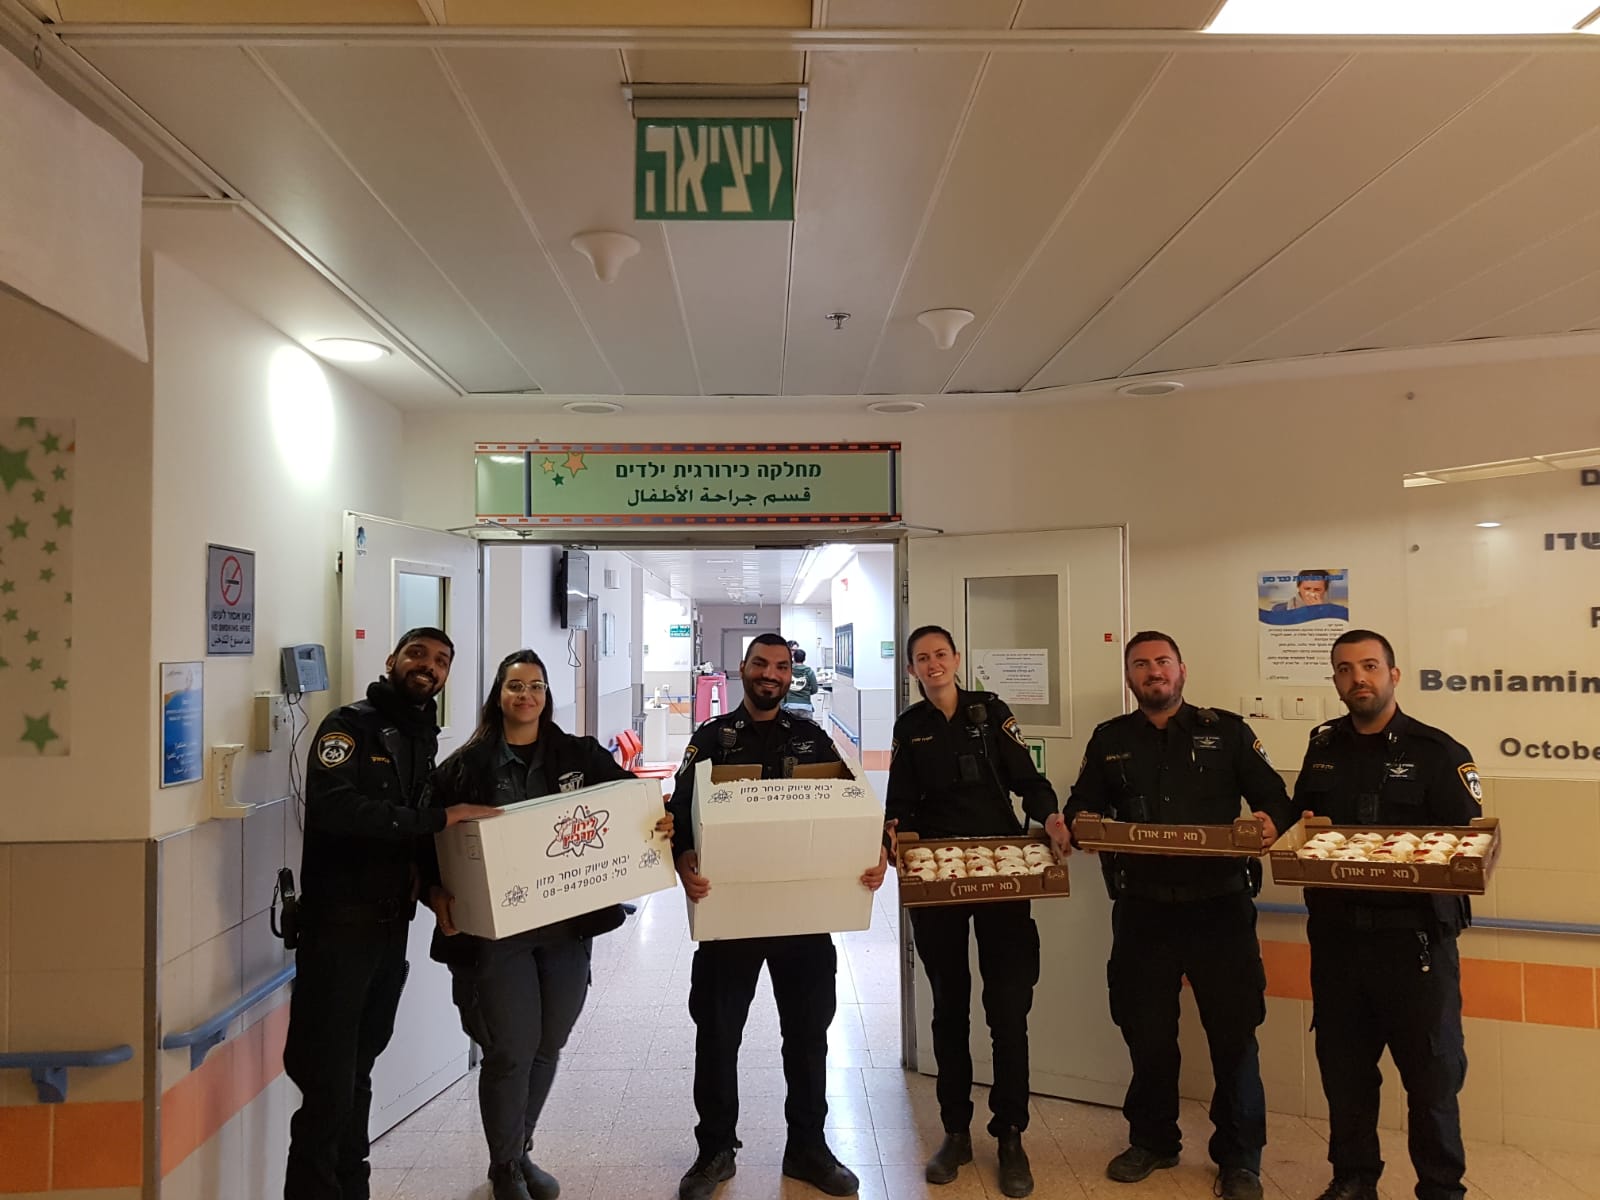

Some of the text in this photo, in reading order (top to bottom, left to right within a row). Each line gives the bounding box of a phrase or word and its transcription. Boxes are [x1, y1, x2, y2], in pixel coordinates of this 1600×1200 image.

[645, 125, 765, 213] יציאה
[615, 462, 822, 480] מחלקה כירורגית ילדים
[628, 485, 812, 507] قسم جراحة الأطفال
[1419, 669, 1600, 693] Beniamin
[1499, 737, 1600, 760] Octobe
[740, 787, 758, 795] מזון
[787, 785, 811, 795] שיווק
[746, 794, 811, 803] 08-9479003
[1136, 829, 1159, 841] אורן
[585, 859, 609, 875] שיווק
[611, 855, 630, 866] יבוא
[558, 868, 582, 880] וסחר
[611, 867, 627, 879] טל:
[1339, 866, 1365, 879] אורן
[535, 874, 555, 889] מזון
[542, 873, 608, 898] 08-9479003
[957, 883, 978, 896] אורן
